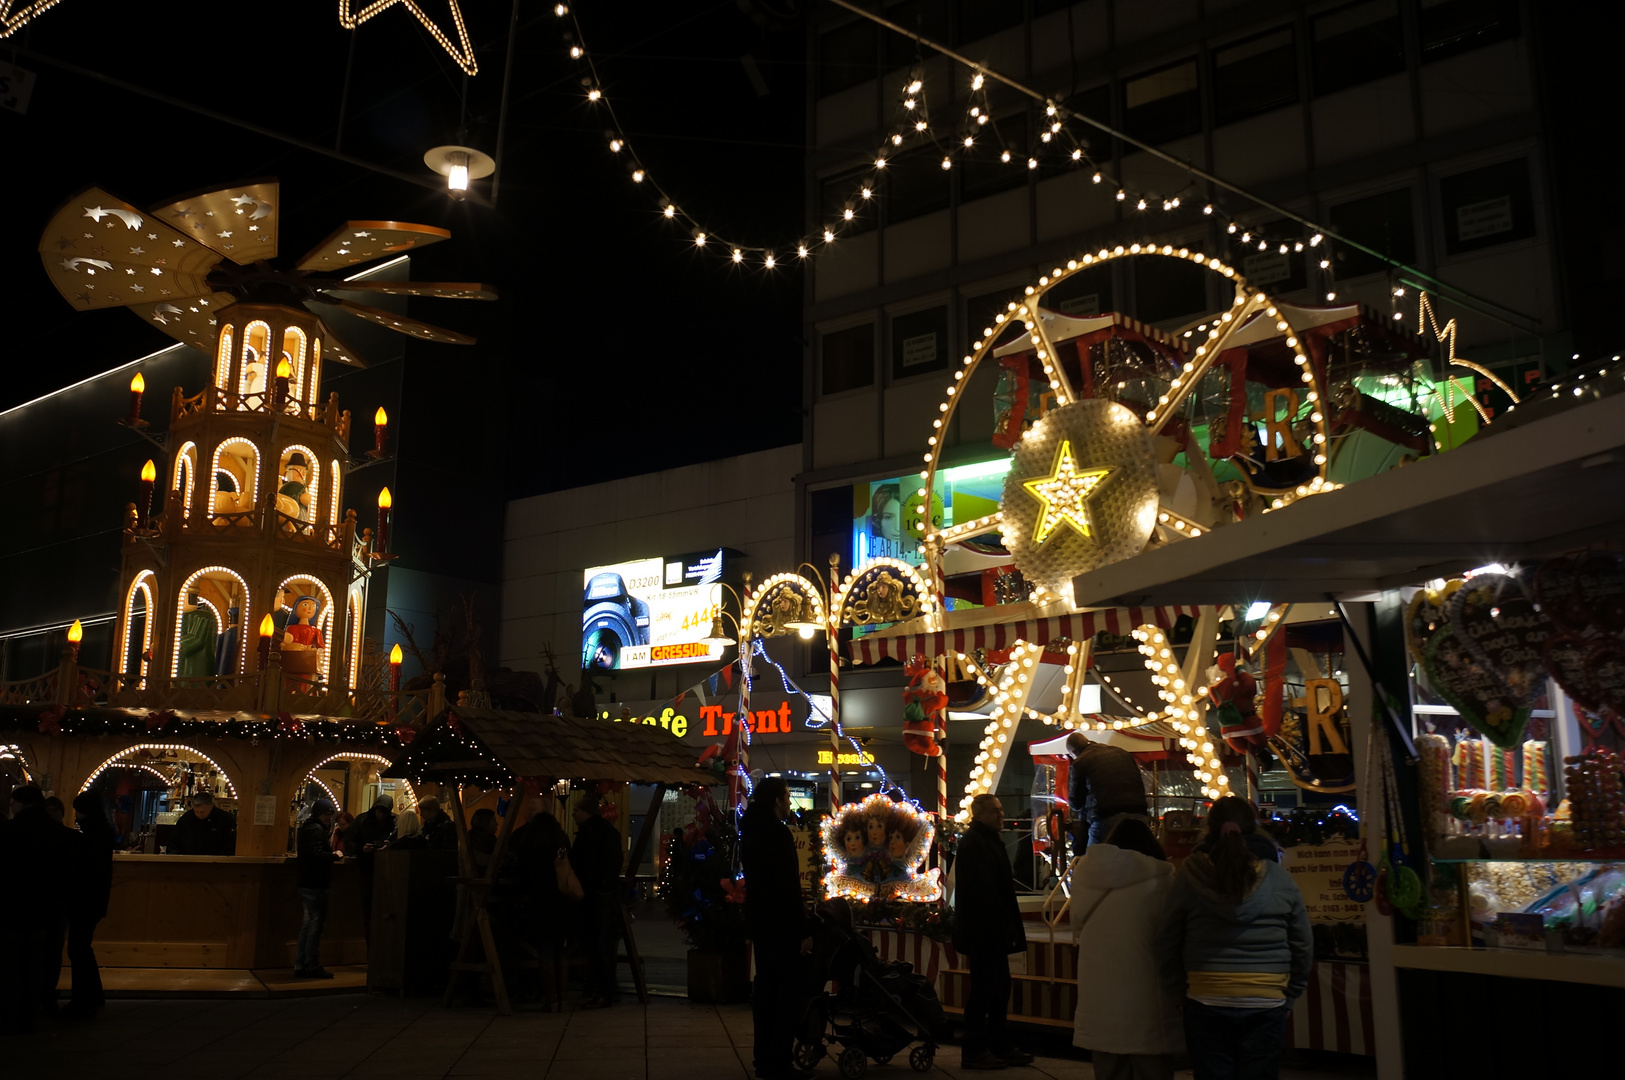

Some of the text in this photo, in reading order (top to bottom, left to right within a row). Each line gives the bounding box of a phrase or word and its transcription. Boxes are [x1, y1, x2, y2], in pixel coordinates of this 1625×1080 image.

[629, 575, 660, 590] D3200
[632, 651, 646, 661] AM
[700, 701, 792, 737] Trent
